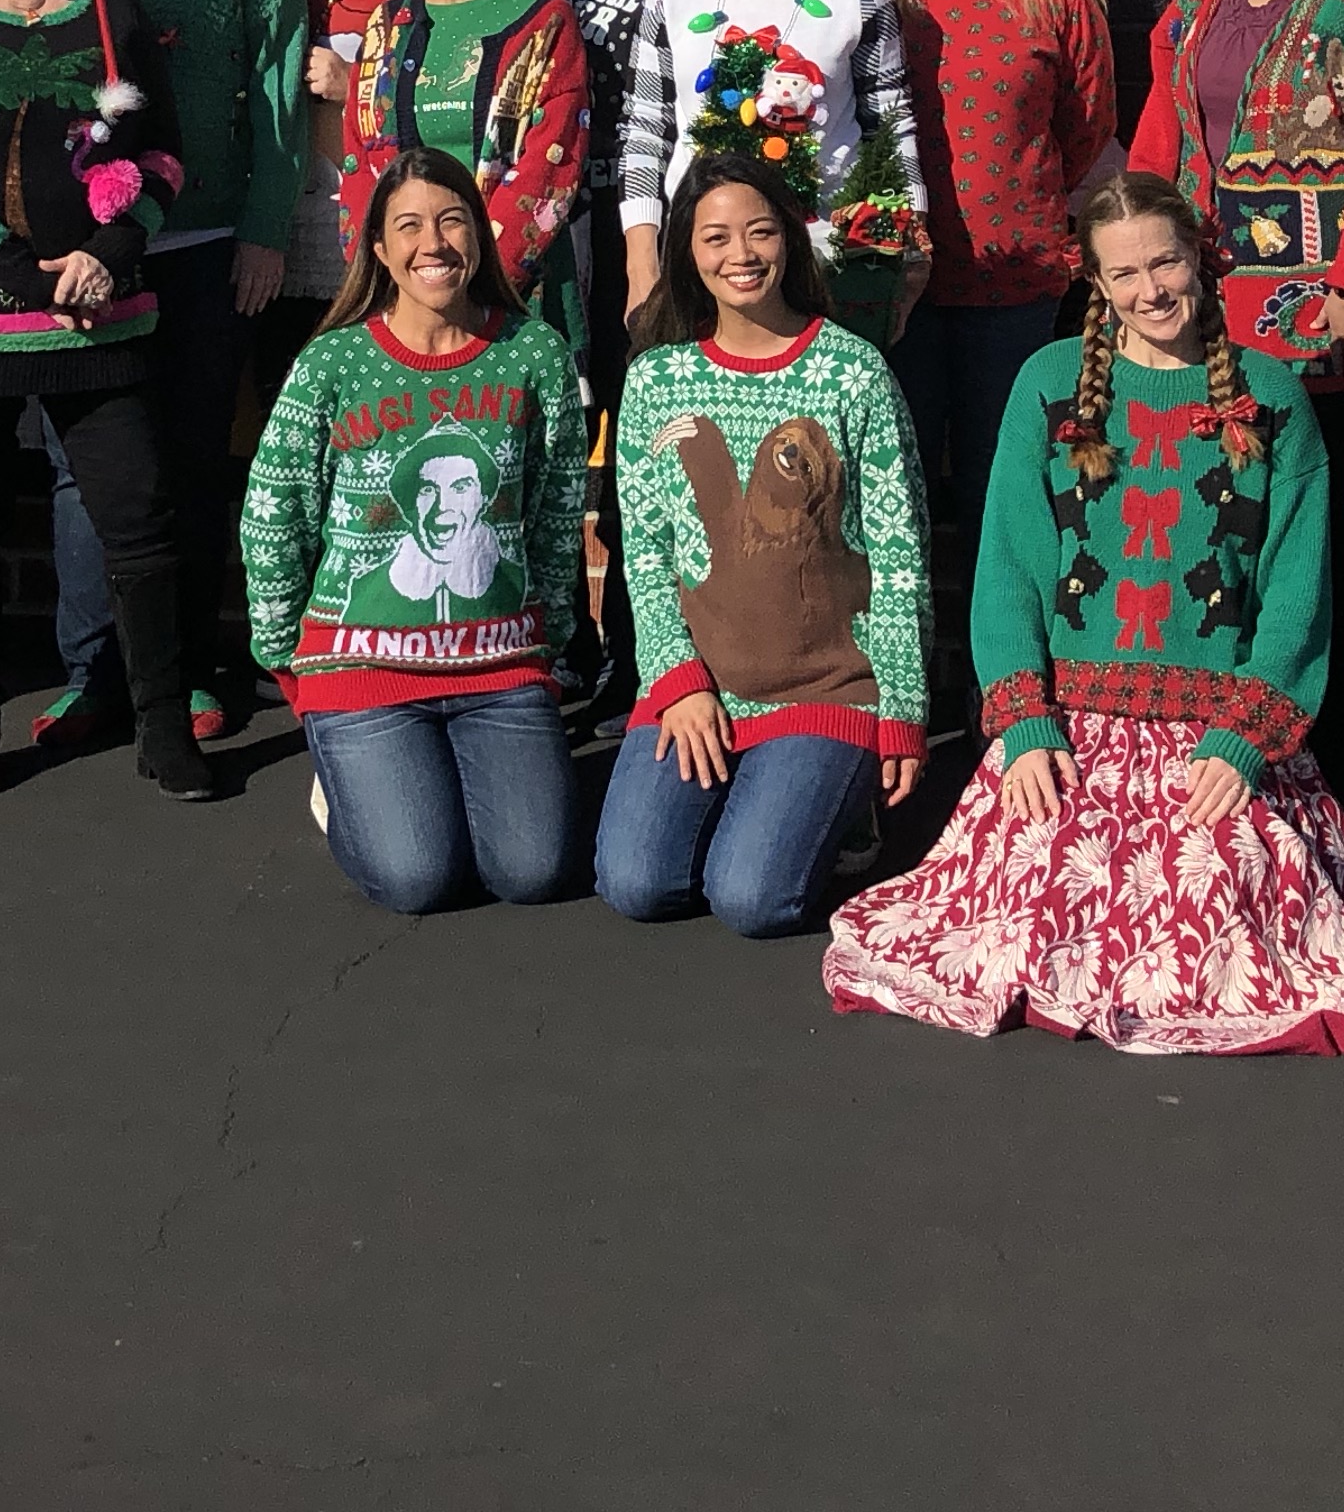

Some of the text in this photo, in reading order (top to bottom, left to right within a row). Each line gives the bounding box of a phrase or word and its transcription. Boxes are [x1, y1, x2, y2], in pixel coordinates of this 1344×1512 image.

[422, 101, 467, 112] watching
[331, 392, 415, 451] OMG!
[332, 628, 347, 654] I
[349, 627, 468, 658] KNOW
